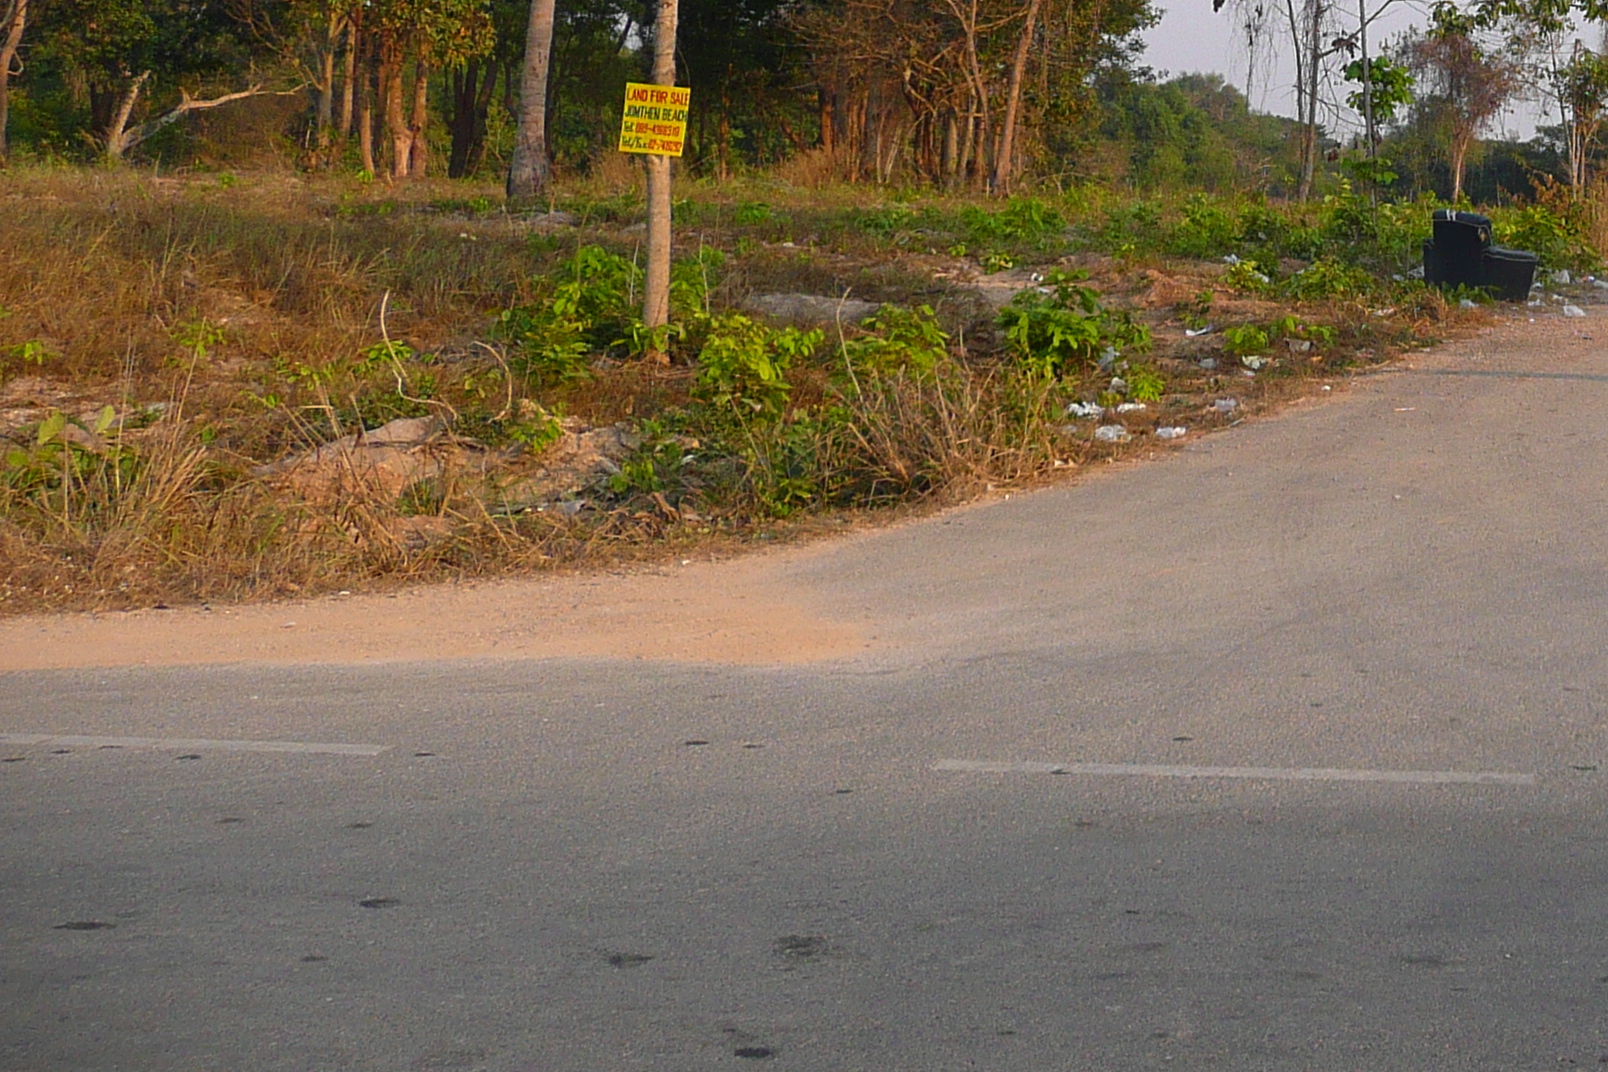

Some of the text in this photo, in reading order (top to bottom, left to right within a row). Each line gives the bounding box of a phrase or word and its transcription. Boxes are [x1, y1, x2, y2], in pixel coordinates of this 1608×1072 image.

[626, 88, 689, 106] LAND FOR SALE
[662, 108, 688, 123] BEACH
